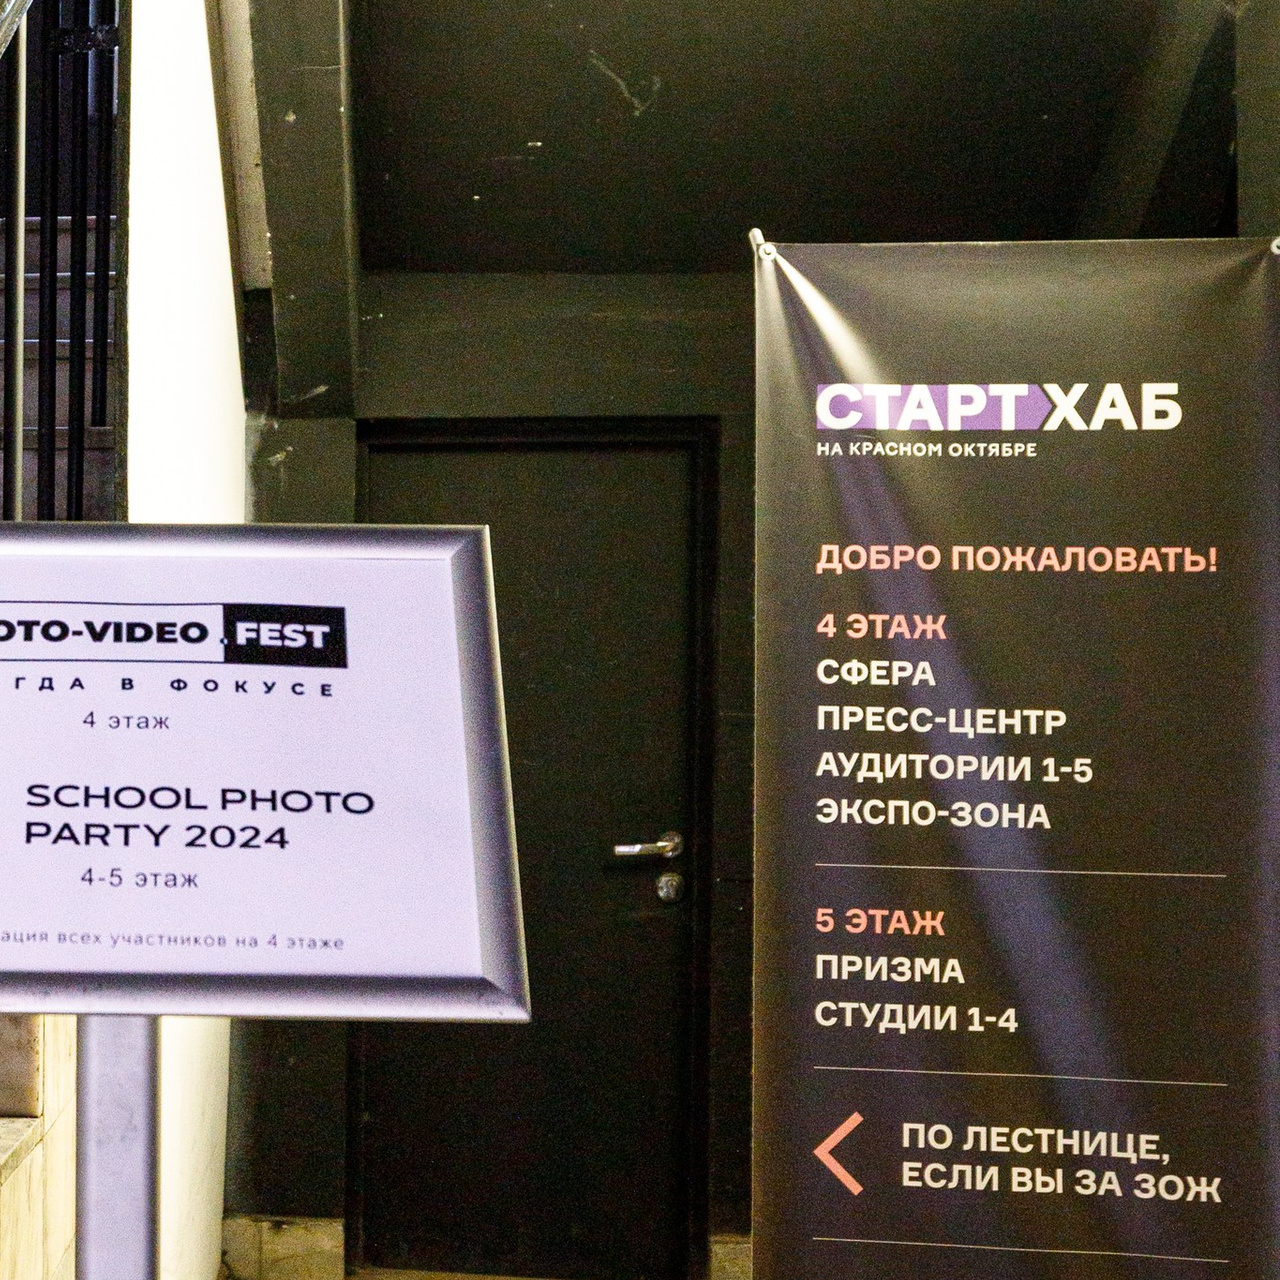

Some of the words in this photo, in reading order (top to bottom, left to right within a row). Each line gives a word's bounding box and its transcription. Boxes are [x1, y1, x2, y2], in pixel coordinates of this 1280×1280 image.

[815, 441, 844, 458] НА
[849, 440, 943, 458] КРАСНОМ
[947, 441, 1038, 459] ОКТЯБРЕ
[816, 543, 942, 575] ДОБРО
[950, 544, 1218, 574] ПОЖАЛОВАТЬ!
[816, 613, 837, 639] 4
[845, 613, 948, 641] ЭТАЖ
[120, 676, 135, 692] В
[168, 676, 333, 698] ФОКУСЕ
[816, 658, 937, 687] СФЕРА
[82, 710, 97, 730] 4
[108, 714, 170, 731] этаж
[816, 705, 1068, 738] ПРЕСС-ЦЕНТР
[815, 751, 1032, 784] АУДИТОРИИ
[1041, 756, 1095, 784] 1-5
[25, 783, 208, 811] SCHOOL
[220, 787, 376, 815] PHOTO
[816, 798, 1052, 830] ЭКСПО-ЗОНА
[24, 821, 171, 848] PARTY
[184, 824, 290, 851] 2024
[80, 867, 124, 888] 4-5
[134, 871, 199, 889] этаж
[815, 907, 836, 934] 5
[844, 907, 946, 937] ЭТАЖ
[56, 930, 103, 945] всех
[109, 931, 228, 950] участников
[235, 935, 260, 949] на
[266, 933, 279, 949] 4
[287, 936, 346, 951] этаже
[815, 954, 966, 985] ПРИЗМА
[814, 1001, 958, 1034] СТУДИИ
[966, 1006, 1019, 1034] 1-4
[902, 1122, 954, 1151] ПО
[962, 1125, 1171, 1165] ЛЕСТНИЦЕ,
[901, 1161, 1000, 1193] ЕСЛИ
[1010, 1167, 1065, 1195] ВЫ
[1073, 1169, 1124, 1198] ЗА
[1133, 1172, 1223, 1204] ЗОЖ
